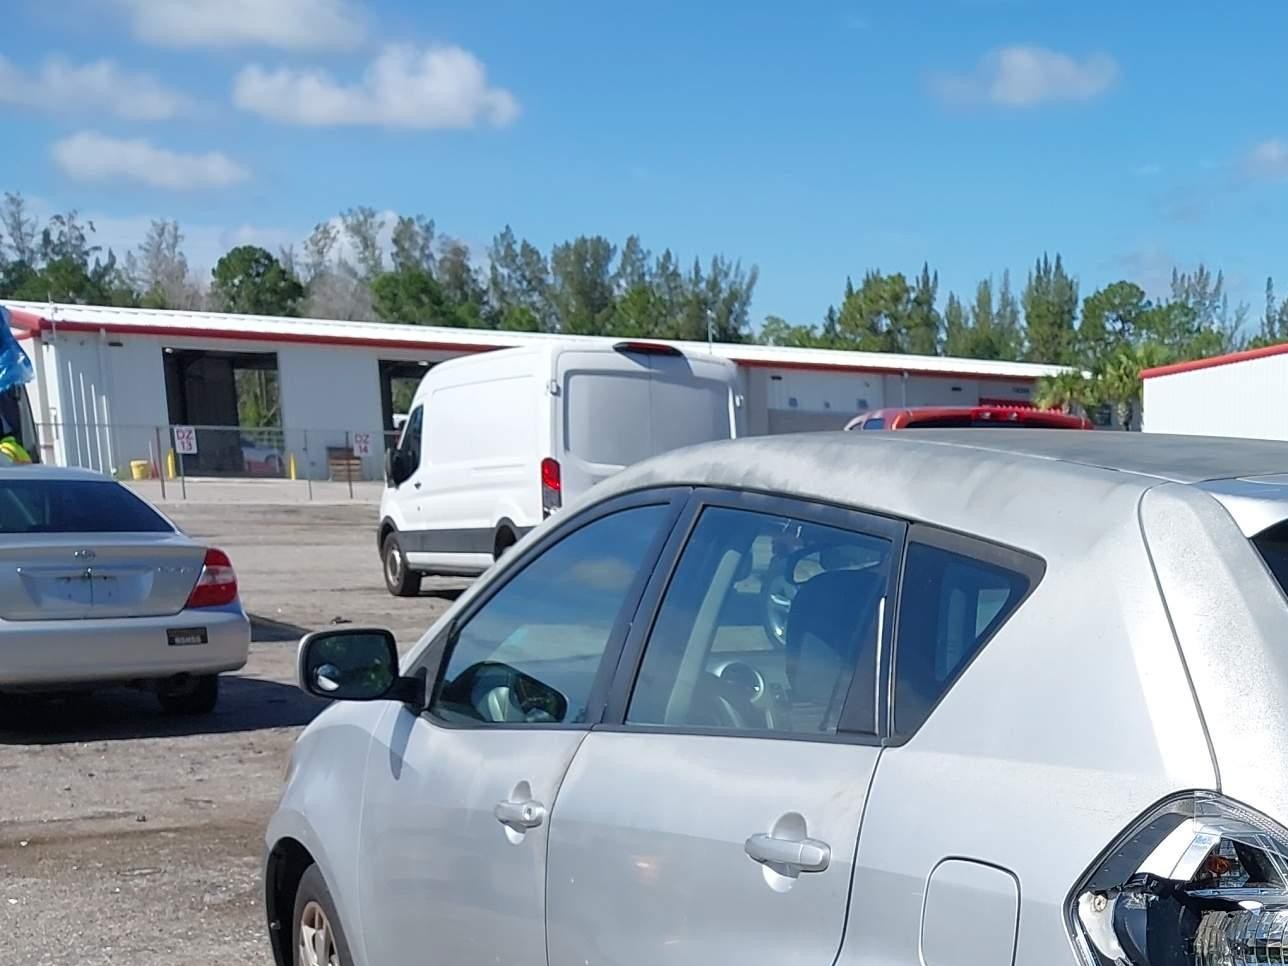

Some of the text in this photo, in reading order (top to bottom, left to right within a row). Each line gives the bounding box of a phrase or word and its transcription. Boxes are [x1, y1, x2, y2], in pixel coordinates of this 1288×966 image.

[176, 430, 194, 440] DZ
[354, 433, 370, 444] DZ
[181, 440, 193, 451] 13
